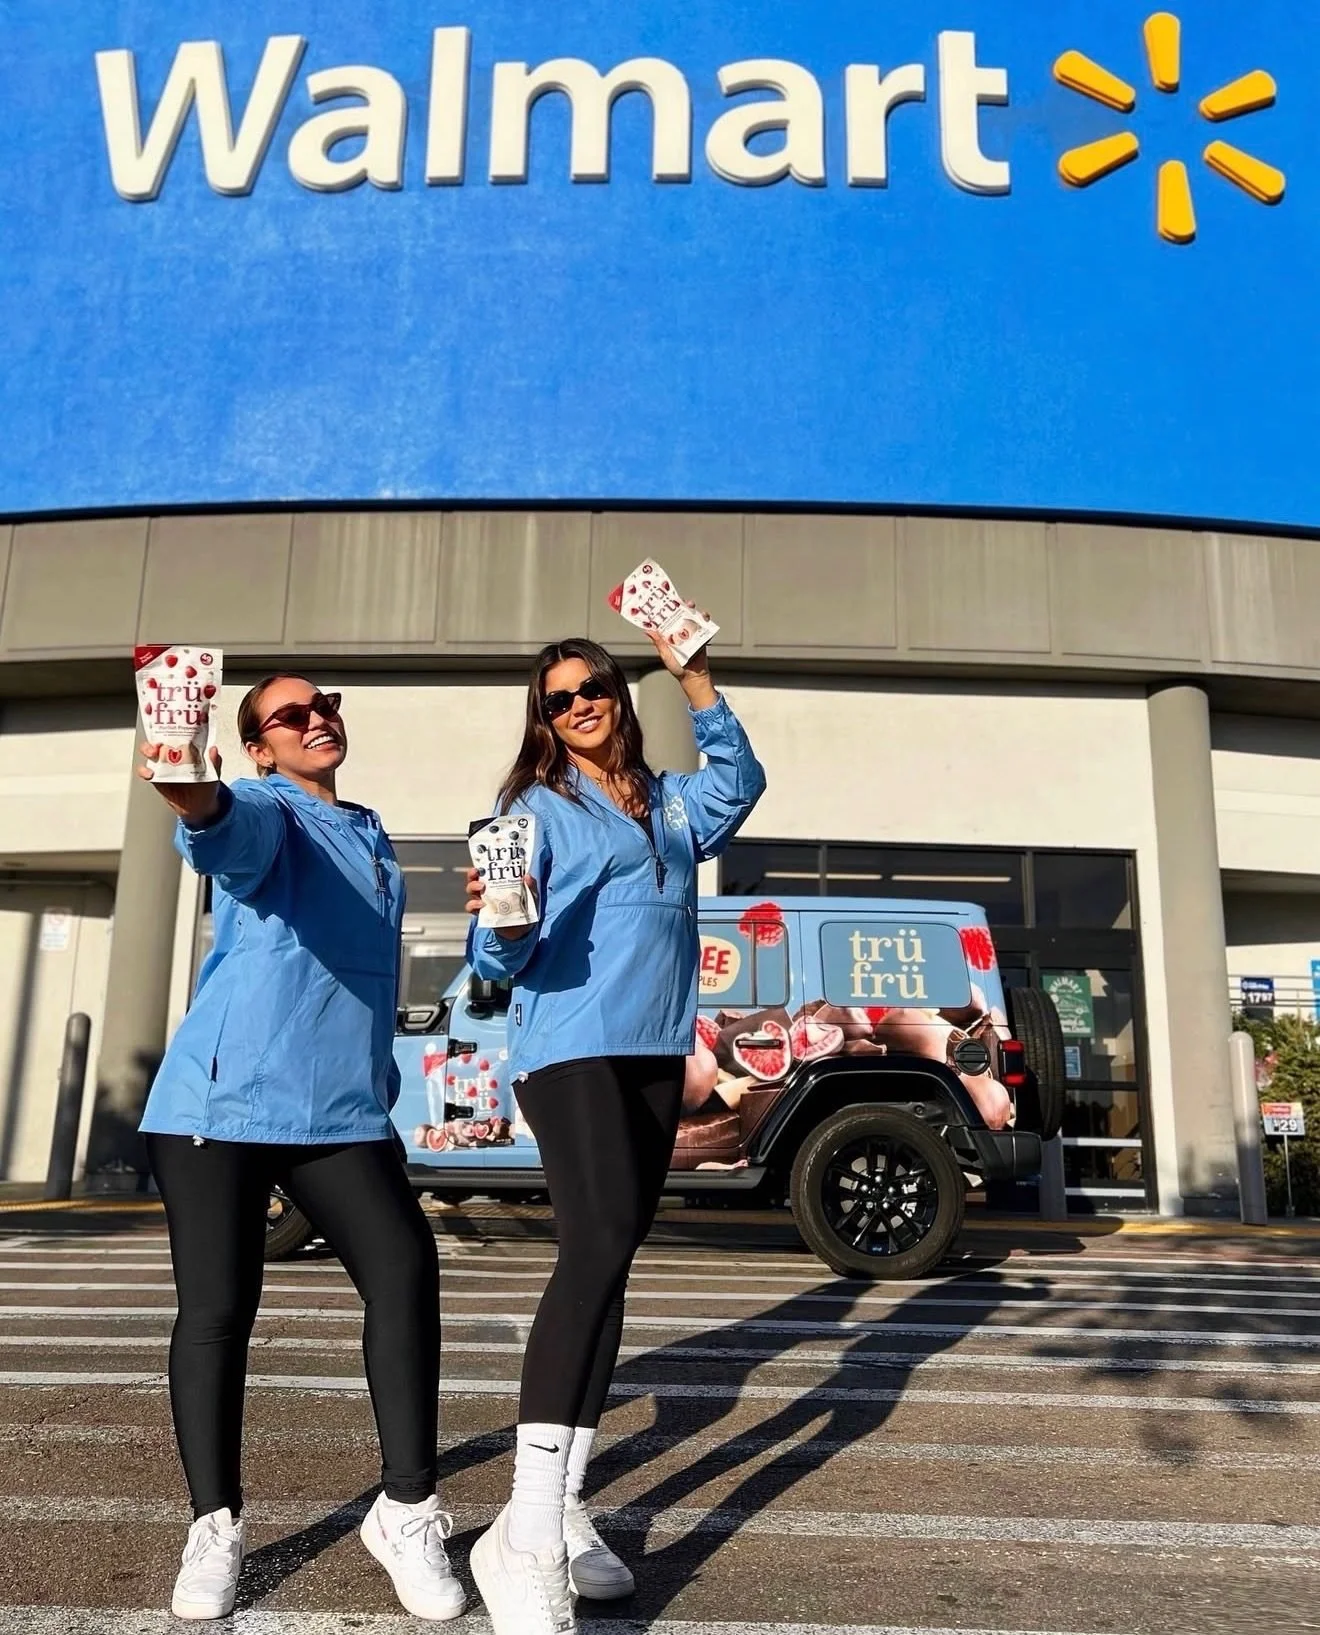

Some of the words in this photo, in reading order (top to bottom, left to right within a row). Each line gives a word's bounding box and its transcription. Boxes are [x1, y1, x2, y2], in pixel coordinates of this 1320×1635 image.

[95, 26, 1011, 202] Walmart
[155, 681, 202, 702] trü
[154, 702, 201, 725] frü
[485, 842, 522, 861] trü
[487, 861, 523, 881] frü
[849, 929, 926, 963] trü
[702, 946, 731, 974] EE
[699, 975, 718, 987] PLES
[850, 961, 928, 1000] frü
